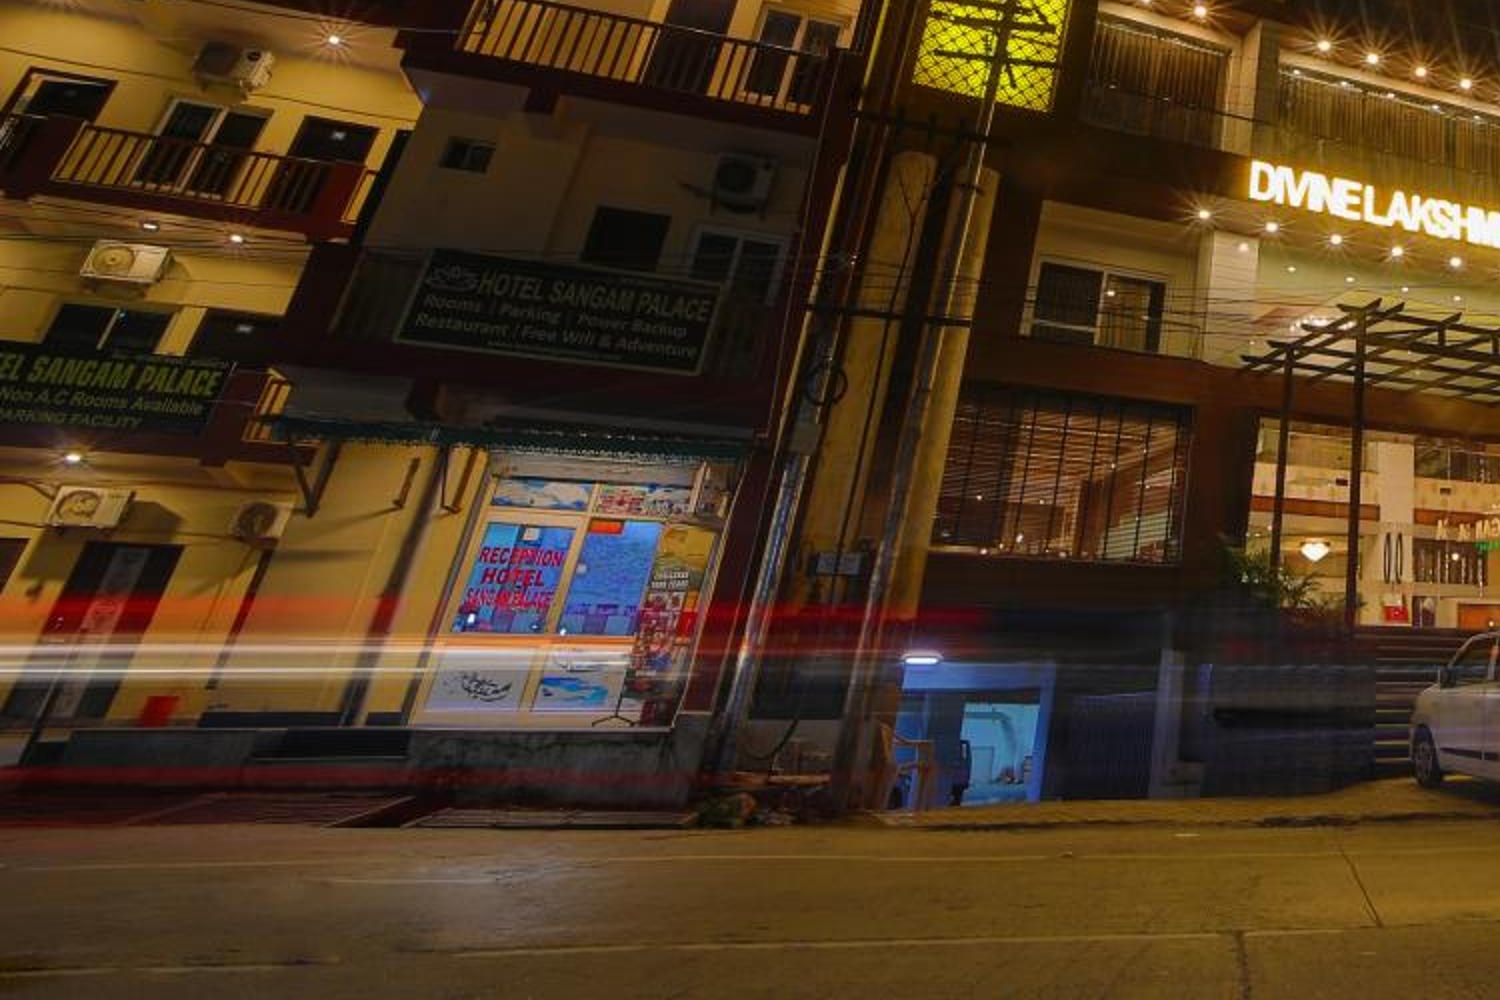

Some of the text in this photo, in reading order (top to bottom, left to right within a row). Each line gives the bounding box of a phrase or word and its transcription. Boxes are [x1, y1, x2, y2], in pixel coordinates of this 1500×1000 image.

[1248, 159, 1363, 222] DIVINE
[479, 269, 545, 300] HOTEL
[550, 279, 636, 312] SANGAM
[636, 292, 713, 323] PALACE
[415, 312, 509, 338] Restaurant
[27, 355, 137, 390] SANGAM
[136, 364, 224, 397] PALACE
[480, 546, 564, 567] RECEPTION
[480, 567, 545, 587] HOTEL
